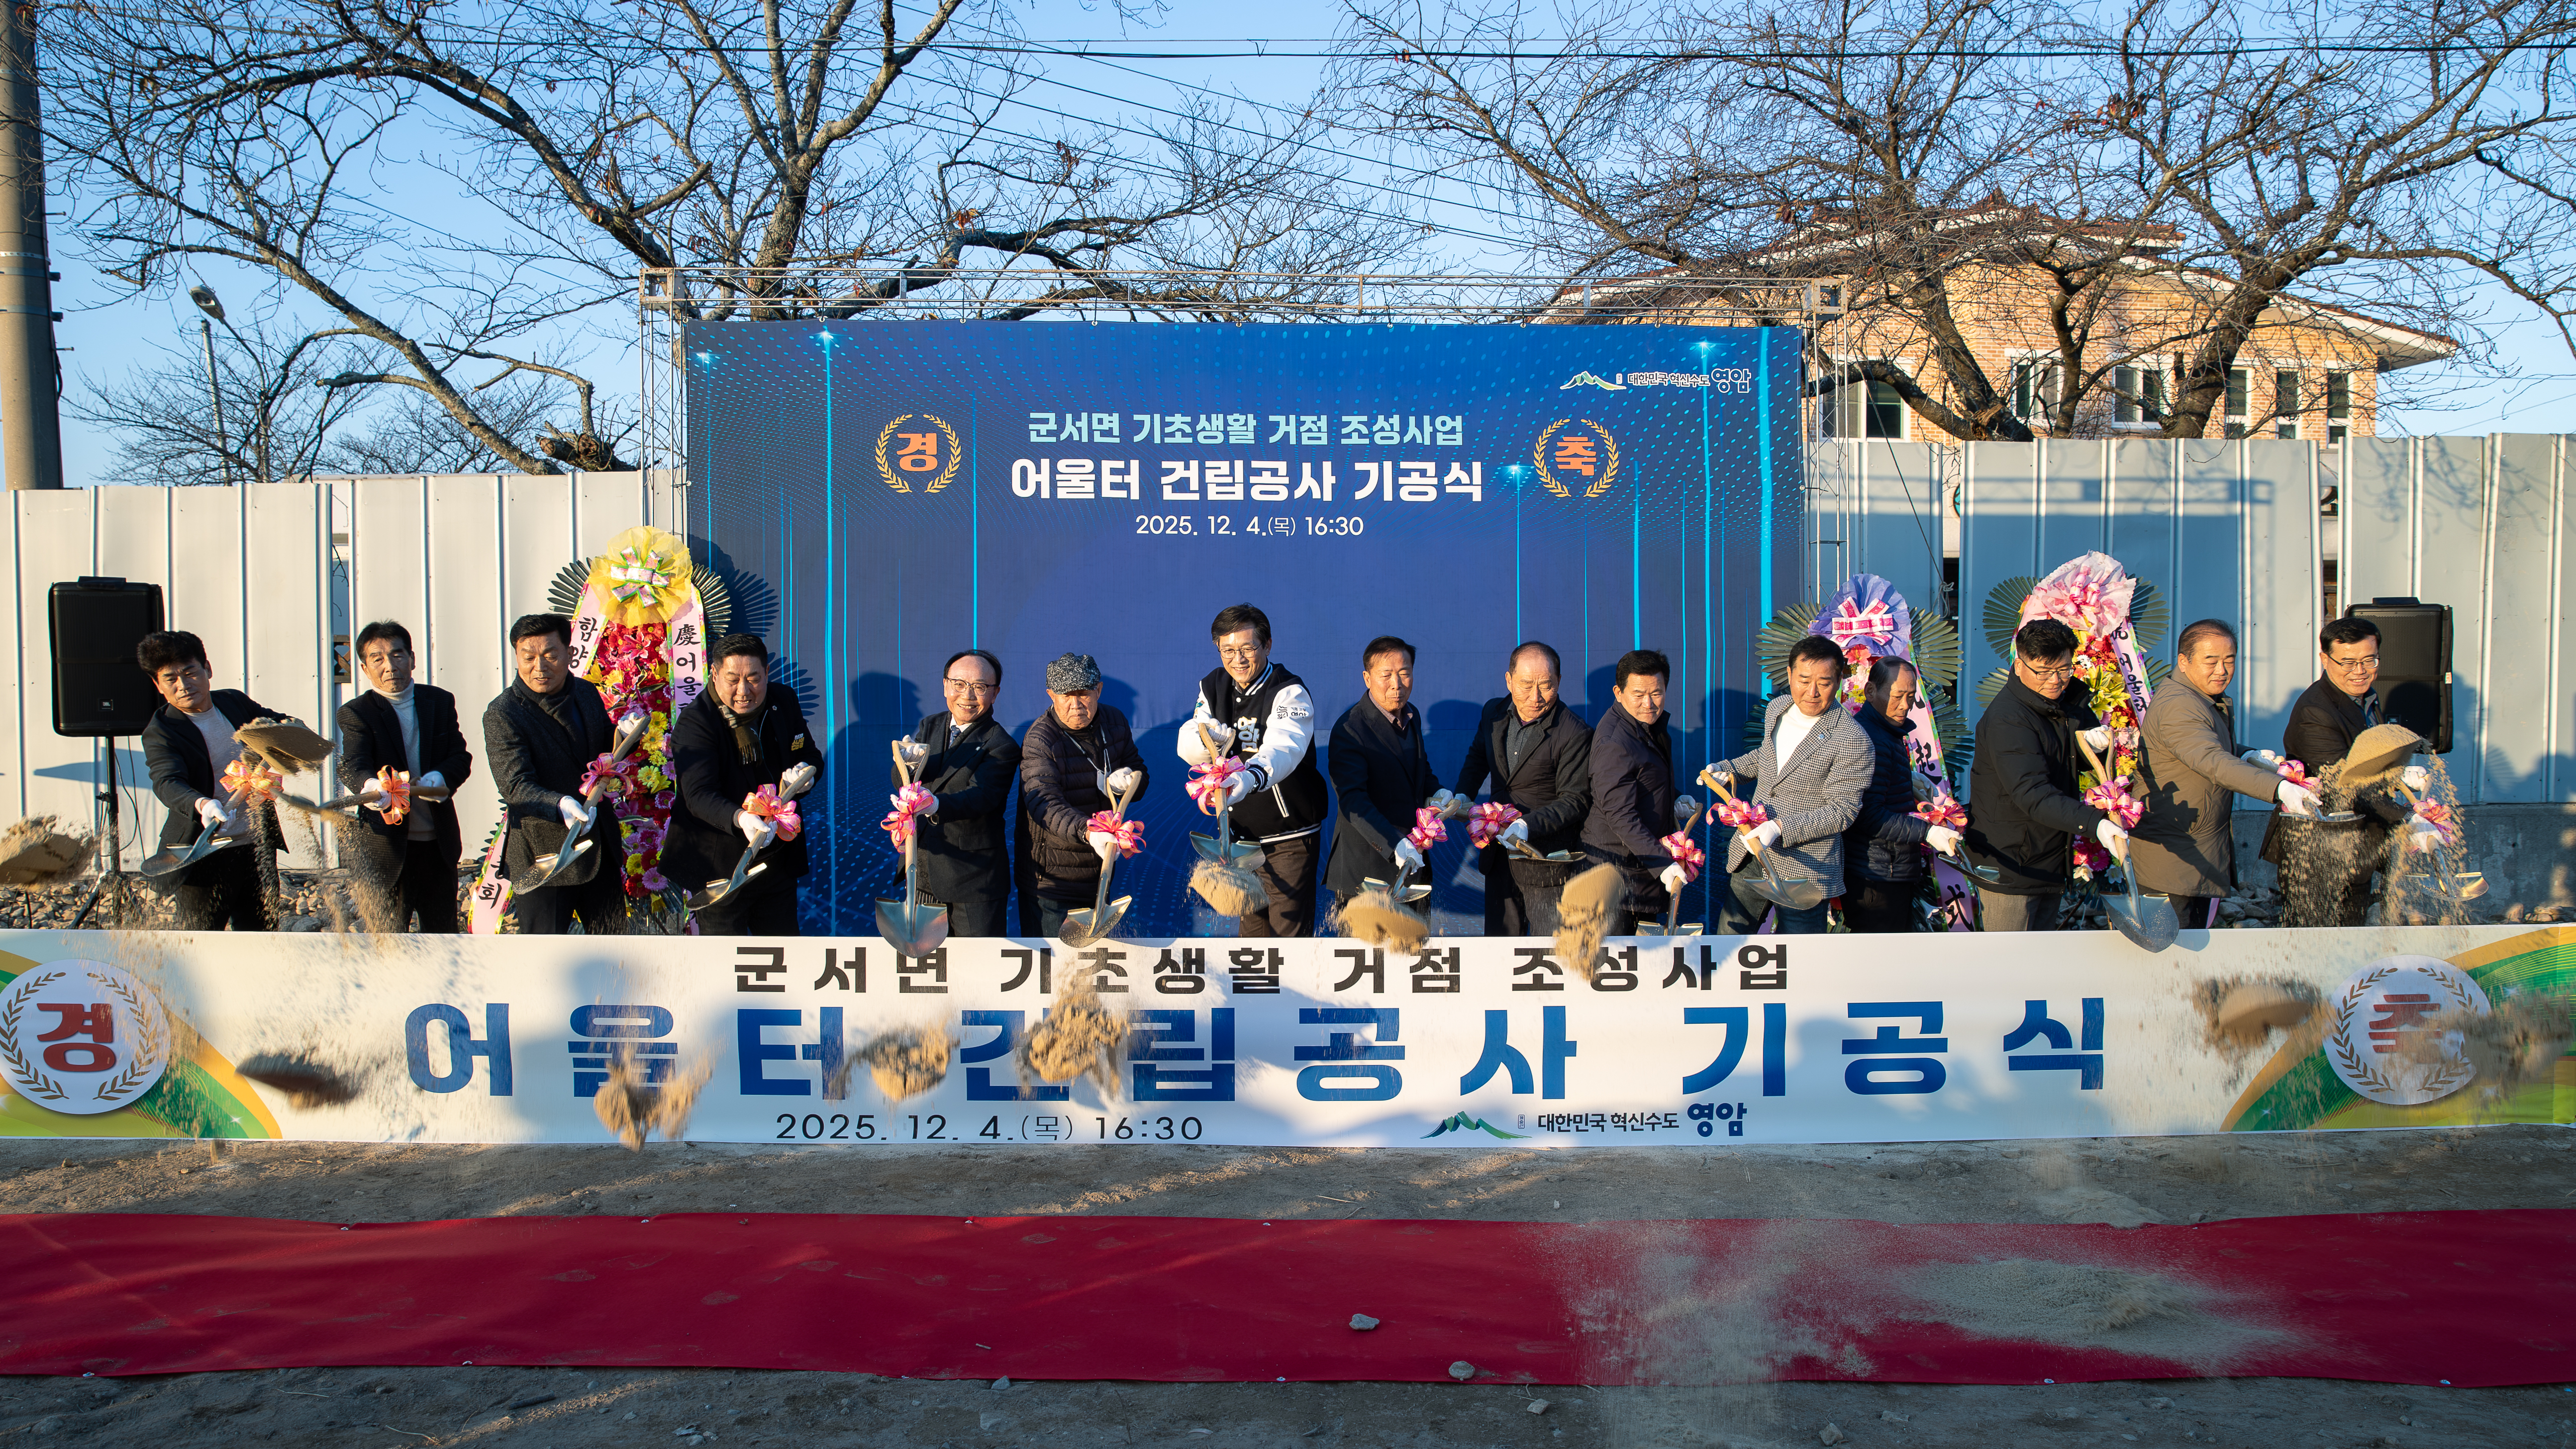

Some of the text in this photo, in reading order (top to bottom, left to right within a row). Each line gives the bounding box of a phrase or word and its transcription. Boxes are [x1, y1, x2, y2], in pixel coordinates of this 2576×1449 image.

[1628, 373, 1668, 386] 대한민국
[1670, 373, 1711, 387] 혁신수도
[1711, 368, 1752, 393] 영암
[1028, 412, 1463, 446] 군서면 기초생활 거점 조성사업
[896, 433, 938, 472] 경
[1555, 436, 1597, 476] 축
[1011, 458, 1482, 502] 어울터 건립공사 기공식
[1136, 515, 1197, 536] 2025.
[1207, 515, 1236, 536] 12.
[1305, 516, 1364, 536] 16:30
[570, 617, 598, 669] 함양
[676, 652, 702, 713] 어울
[734, 944, 1787, 994] 군서면 기초생활 거점 조성사업
[37, 1003, 116, 1072] 경
[405, 997, 2104, 1102] 어울터 건립공사 기공식
[2369, 994, 2444, 1063] 축
[777, 1113, 887, 1141] 2025.
[908, 1114, 959, 1141] 12.
[1096, 1116, 1202, 1140] 16:30
[1538, 1102, 1748, 1138] 대한민국 혁신수도 영암
